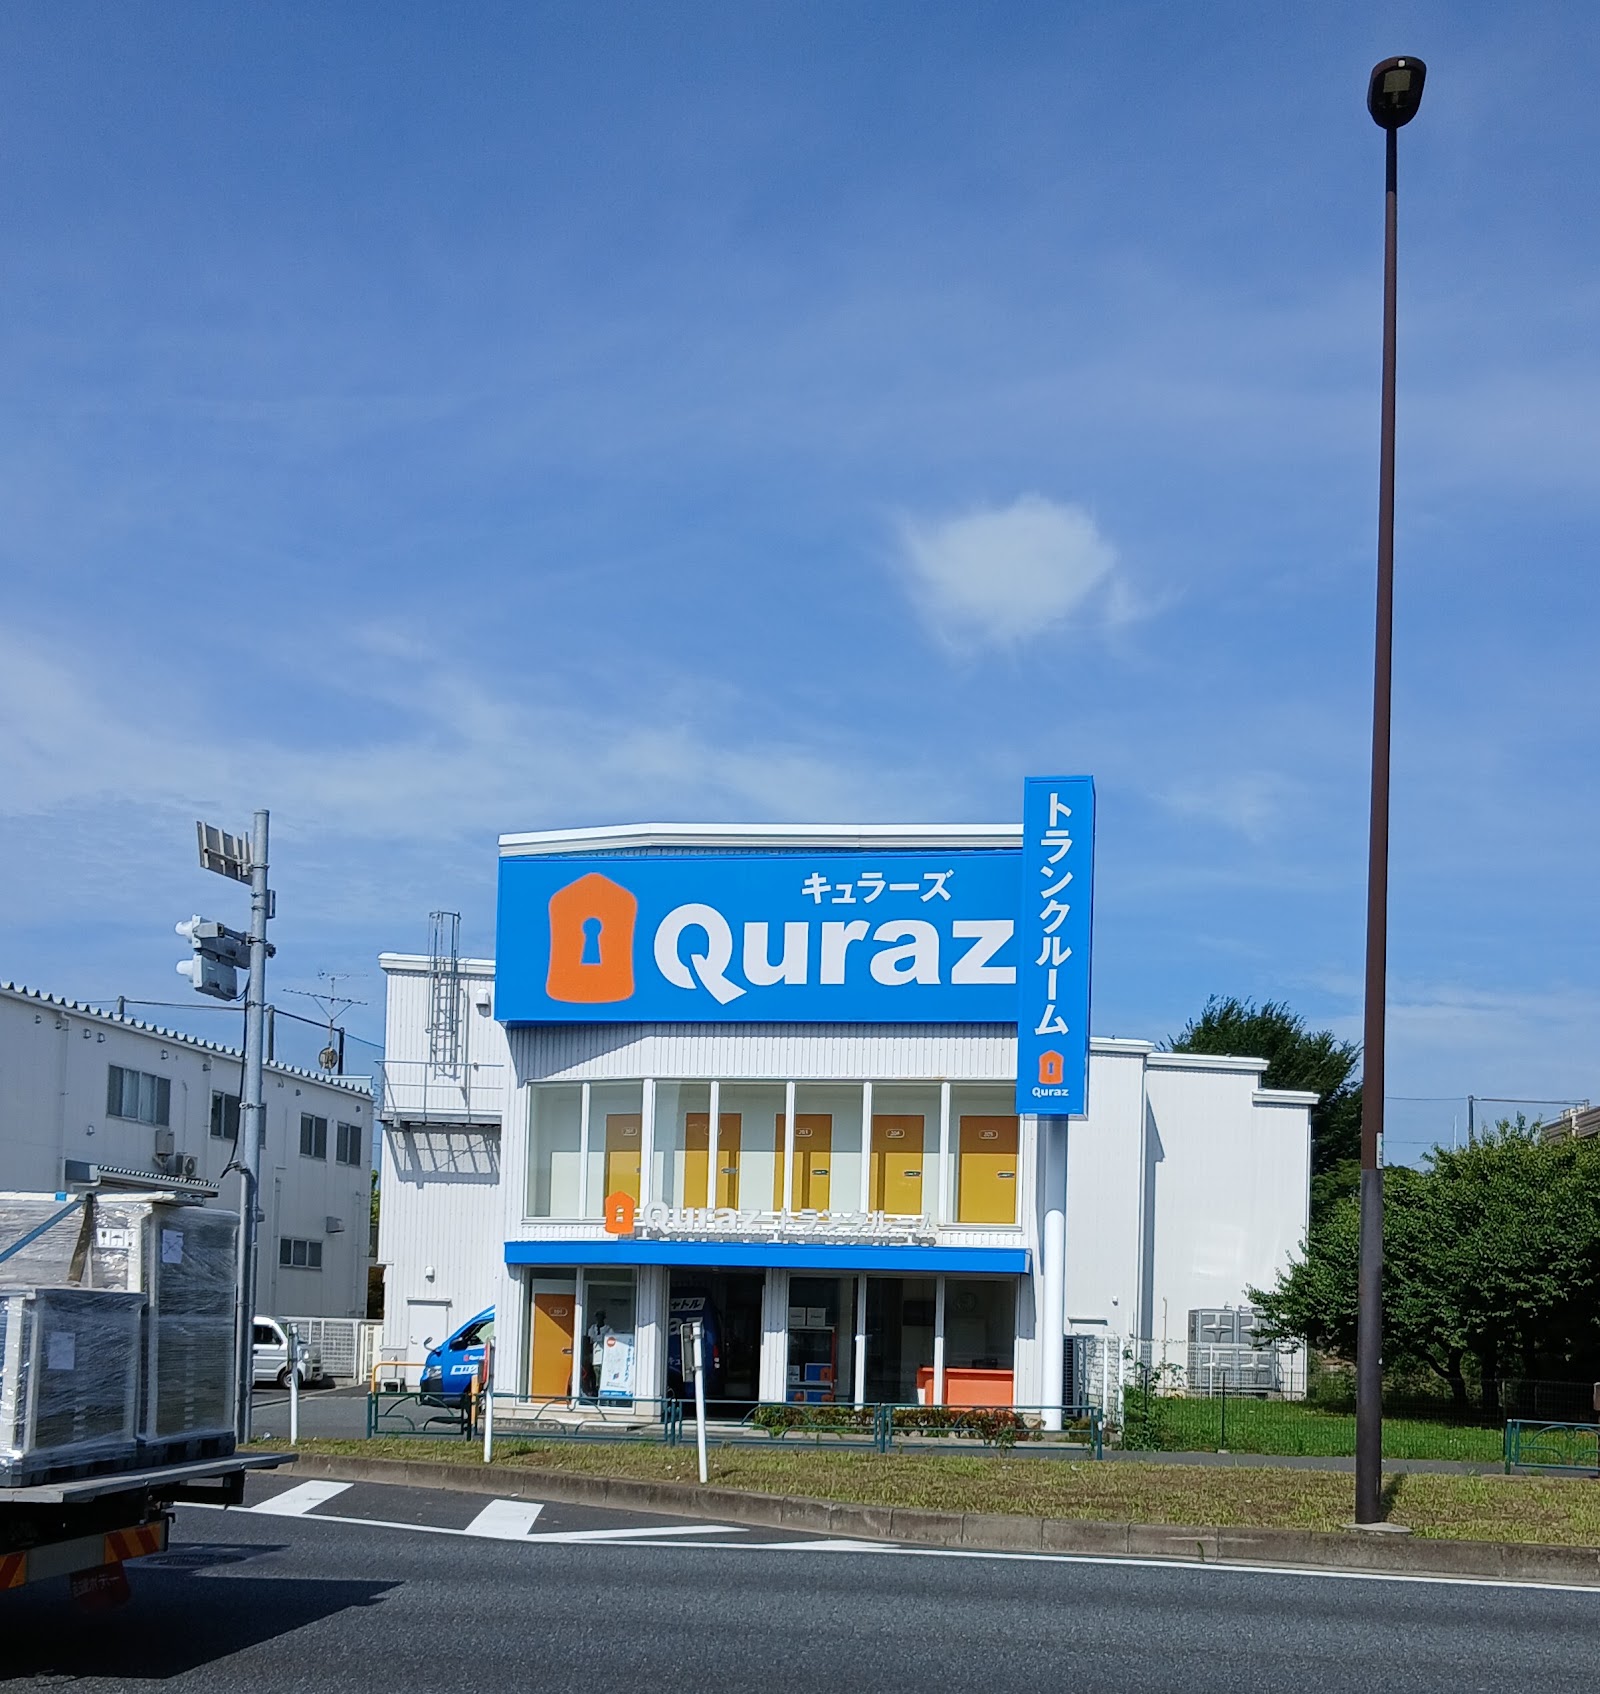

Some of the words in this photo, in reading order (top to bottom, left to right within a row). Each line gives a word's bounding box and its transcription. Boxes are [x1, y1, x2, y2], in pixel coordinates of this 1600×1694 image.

[801, 869, 954, 904] キュラーズ
[1034, 792, 1073, 1037] トランクルーム
[653, 903, 1017, 1005] Quraz
[1031, 1086, 1070, 1098] Quraz
[643, 1200, 761, 1235] Quraz
[780, 1207, 939, 1234] トランクルーム
